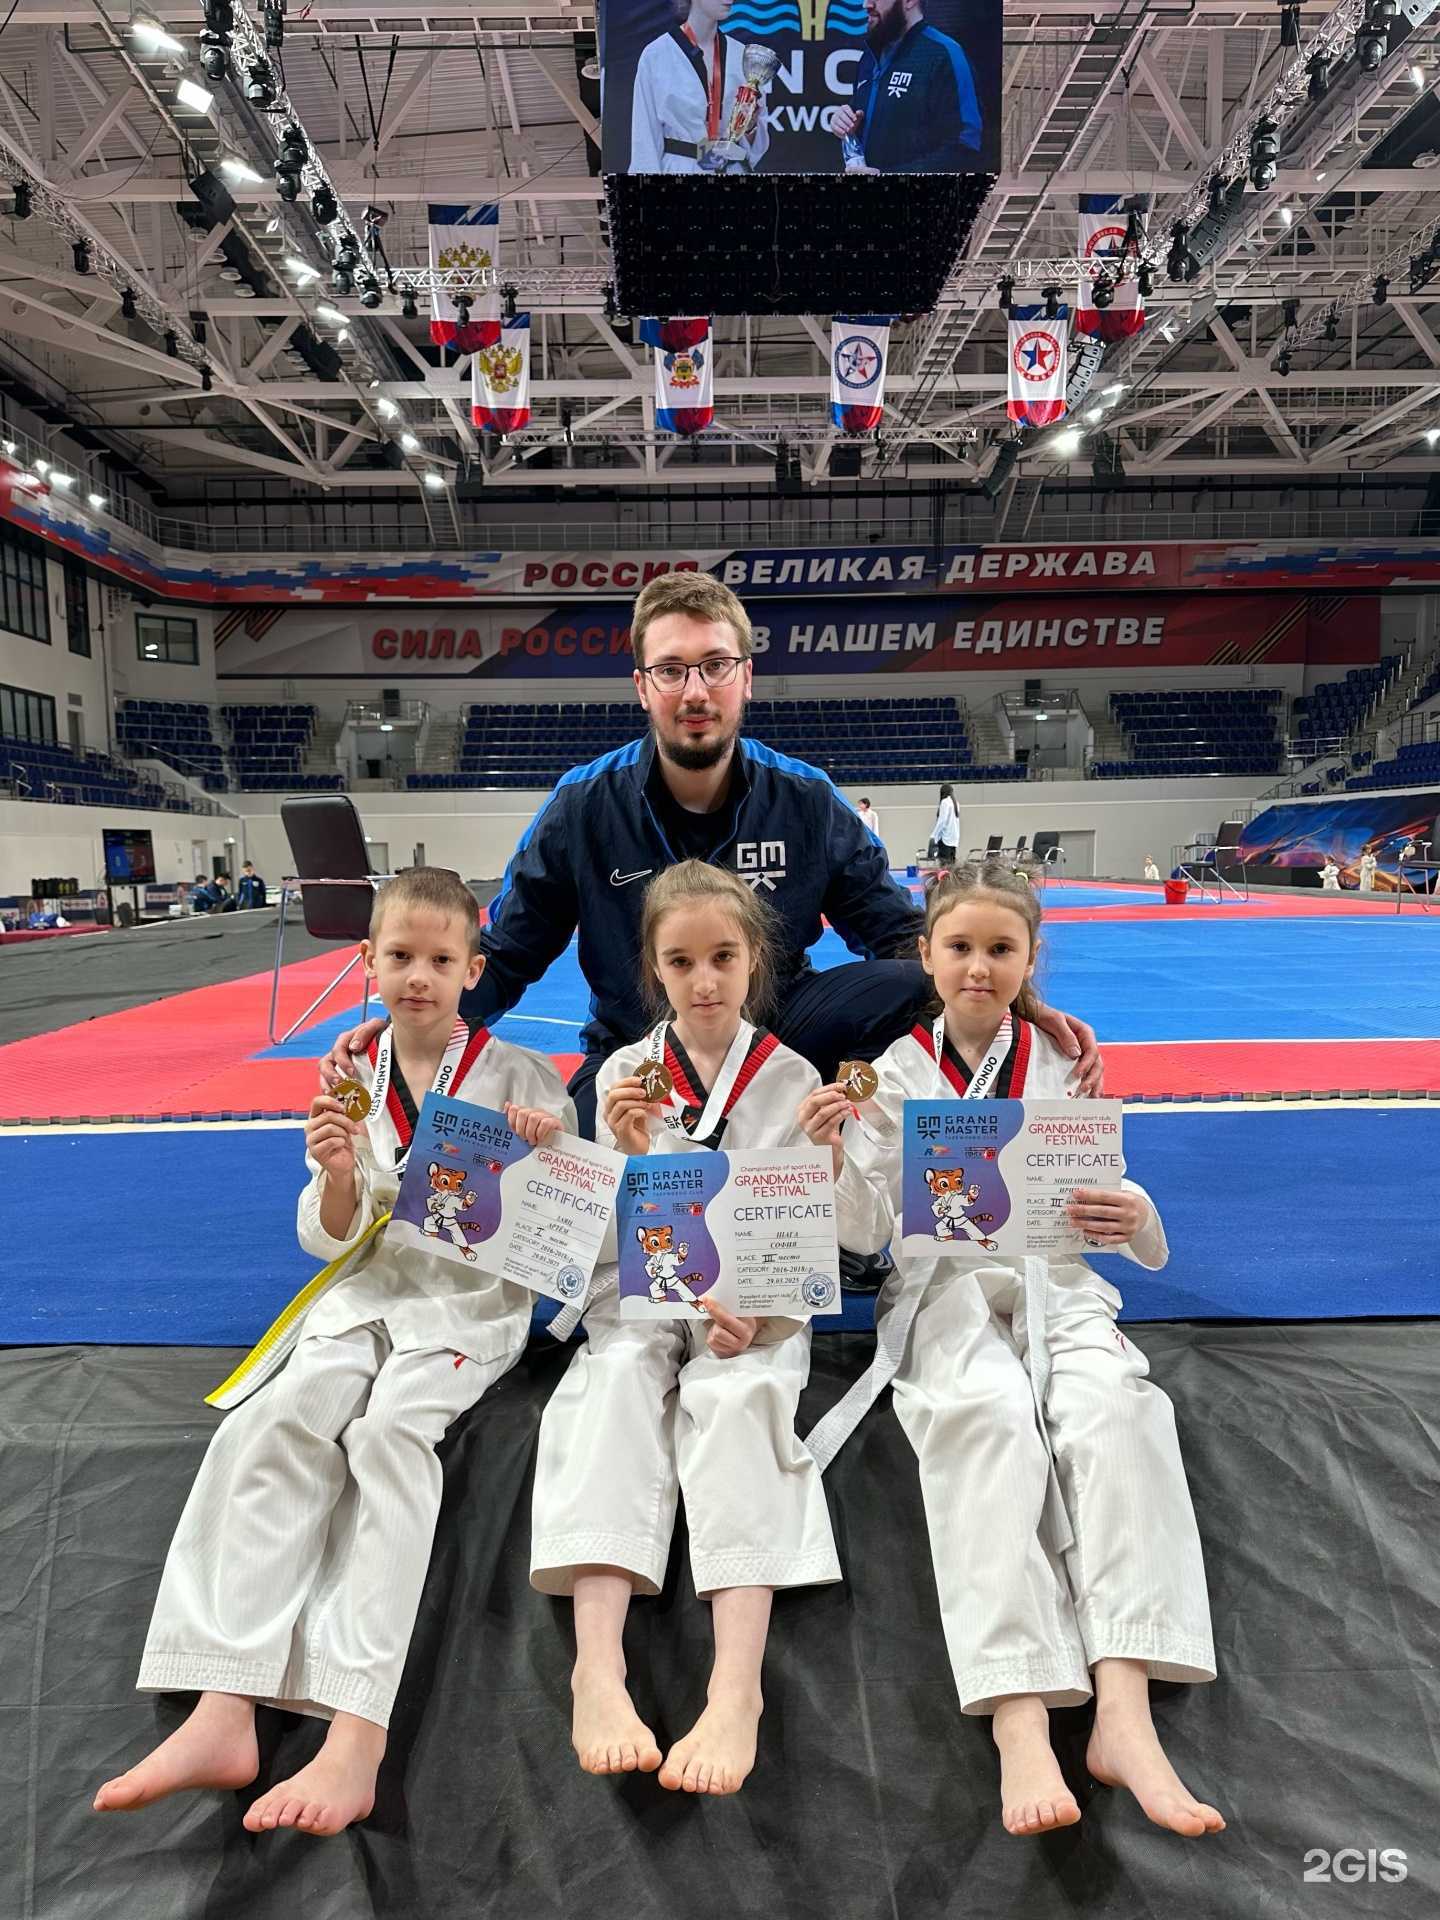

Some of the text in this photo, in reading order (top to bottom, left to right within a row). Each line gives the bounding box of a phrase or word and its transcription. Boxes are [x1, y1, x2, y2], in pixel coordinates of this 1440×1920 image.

[723, 555, 926, 585] ВЕЛИКАЯ
[944, 550, 1157, 584] ДЕРЖАВА
[372, 628, 483, 659] СИЛА
[788, 621, 937, 653] НАШЕМ
[953, 616, 1166, 655] ЕДИНСТВЕ
[945, 1115, 998, 1124] GRAND
[461, 1118, 513, 1141] GRAND
[945, 1125, 998, 1134] MASTER
[1028, 1123, 1118, 1134] GRANDMASTER
[459, 1127, 511, 1150] MASTER
[1045, 1135, 1099, 1146] FESTIVAL
[1026, 1153, 1119, 1167] CERTIFICATE
[537, 1151, 616, 1188] GRANDMASTER
[652, 1168, 704, 1181] GRAND
[549, 1168, 596, 1193] FESTIVAL
[652, 1179, 704, 1191] MASTER
[735, 1171, 829, 1187] GRANDMASTER
[753, 1185, 810, 1198] FESTIVAL
[526, 1180, 610, 1221] CERTIFICATE
[1050, 1198, 1064, 1207] III
[734, 1203, 832, 1221] CERTIFICATE
[762, 1253, 777, 1263] III
